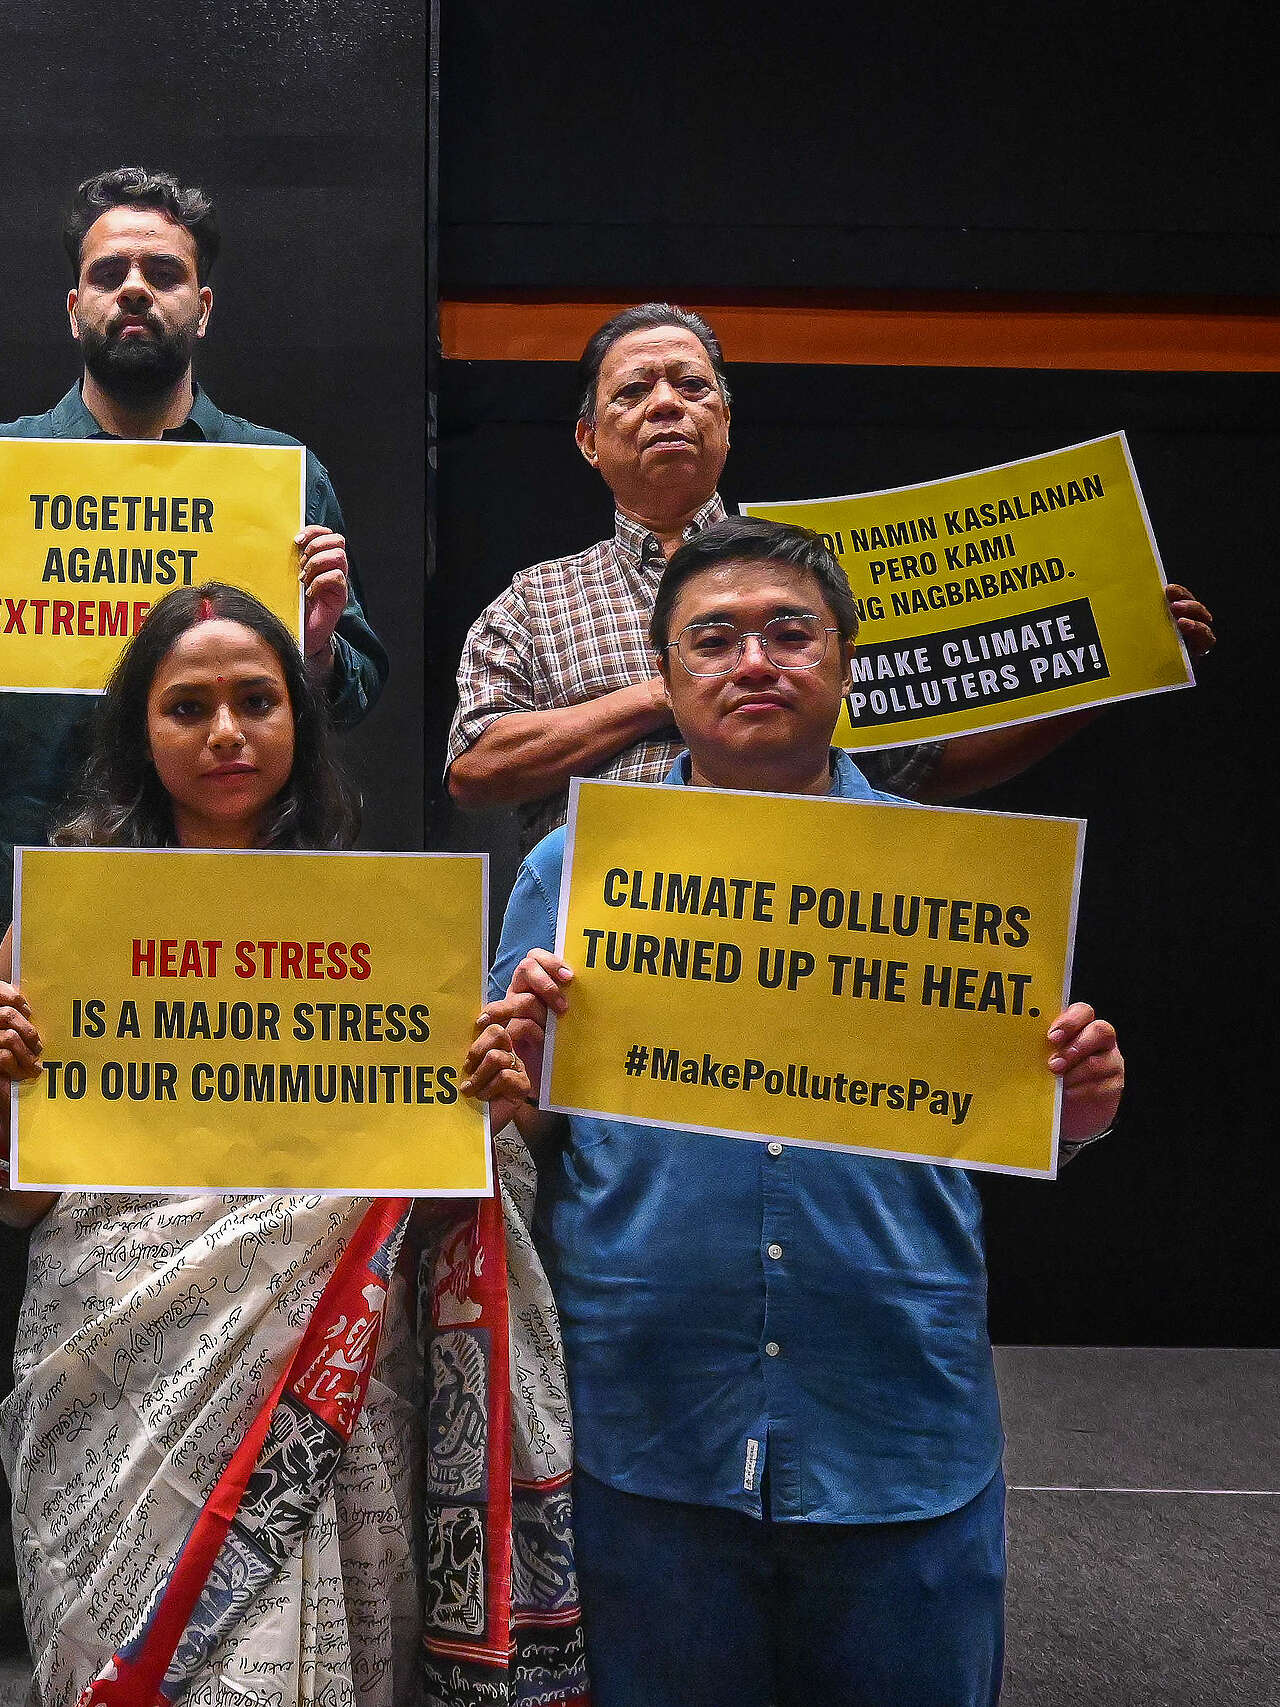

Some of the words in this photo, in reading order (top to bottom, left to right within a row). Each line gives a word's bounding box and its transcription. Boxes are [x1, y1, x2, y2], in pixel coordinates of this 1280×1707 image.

[29, 494, 214, 533] TOGETHER
[851, 516, 938, 553] NAMIN
[944, 474, 1105, 536] KASALANAN
[41, 547, 198, 586] AGAINST
[869, 554, 937, 585] PERO
[943, 533, 1016, 572] KAMI
[893, 557, 1076, 617] NAGBABAYAD.
[851, 647, 931, 684] MAKE
[942, 614, 1075, 665] CLIMATE
[850, 665, 1020, 718] POLLUTERS
[1031, 644, 1101, 685] PAY!
[603, 867, 775, 923] CLIMATE
[788, 883, 1031, 948] POLLUTERS
[131, 939, 223, 979] HEAT
[234, 940, 372, 981] STRESS
[582, 928, 742, 984] TURNED
[757, 948, 816, 990] UP
[827, 955, 907, 1003] THE
[920, 964, 1041, 1018] HEAT.
[72, 999, 108, 1039] IS
[116, 1001, 141, 1038] A
[154, 1000, 281, 1041] MAJOR
[292, 1002, 431, 1043] STRESS
[42, 1060, 87, 1100] TO
[100, 1061, 178, 1101] OUR
[191, 1062, 459, 1106] COMMUNITIES
[623, 1044, 973, 1125] #MakePollutersPay
